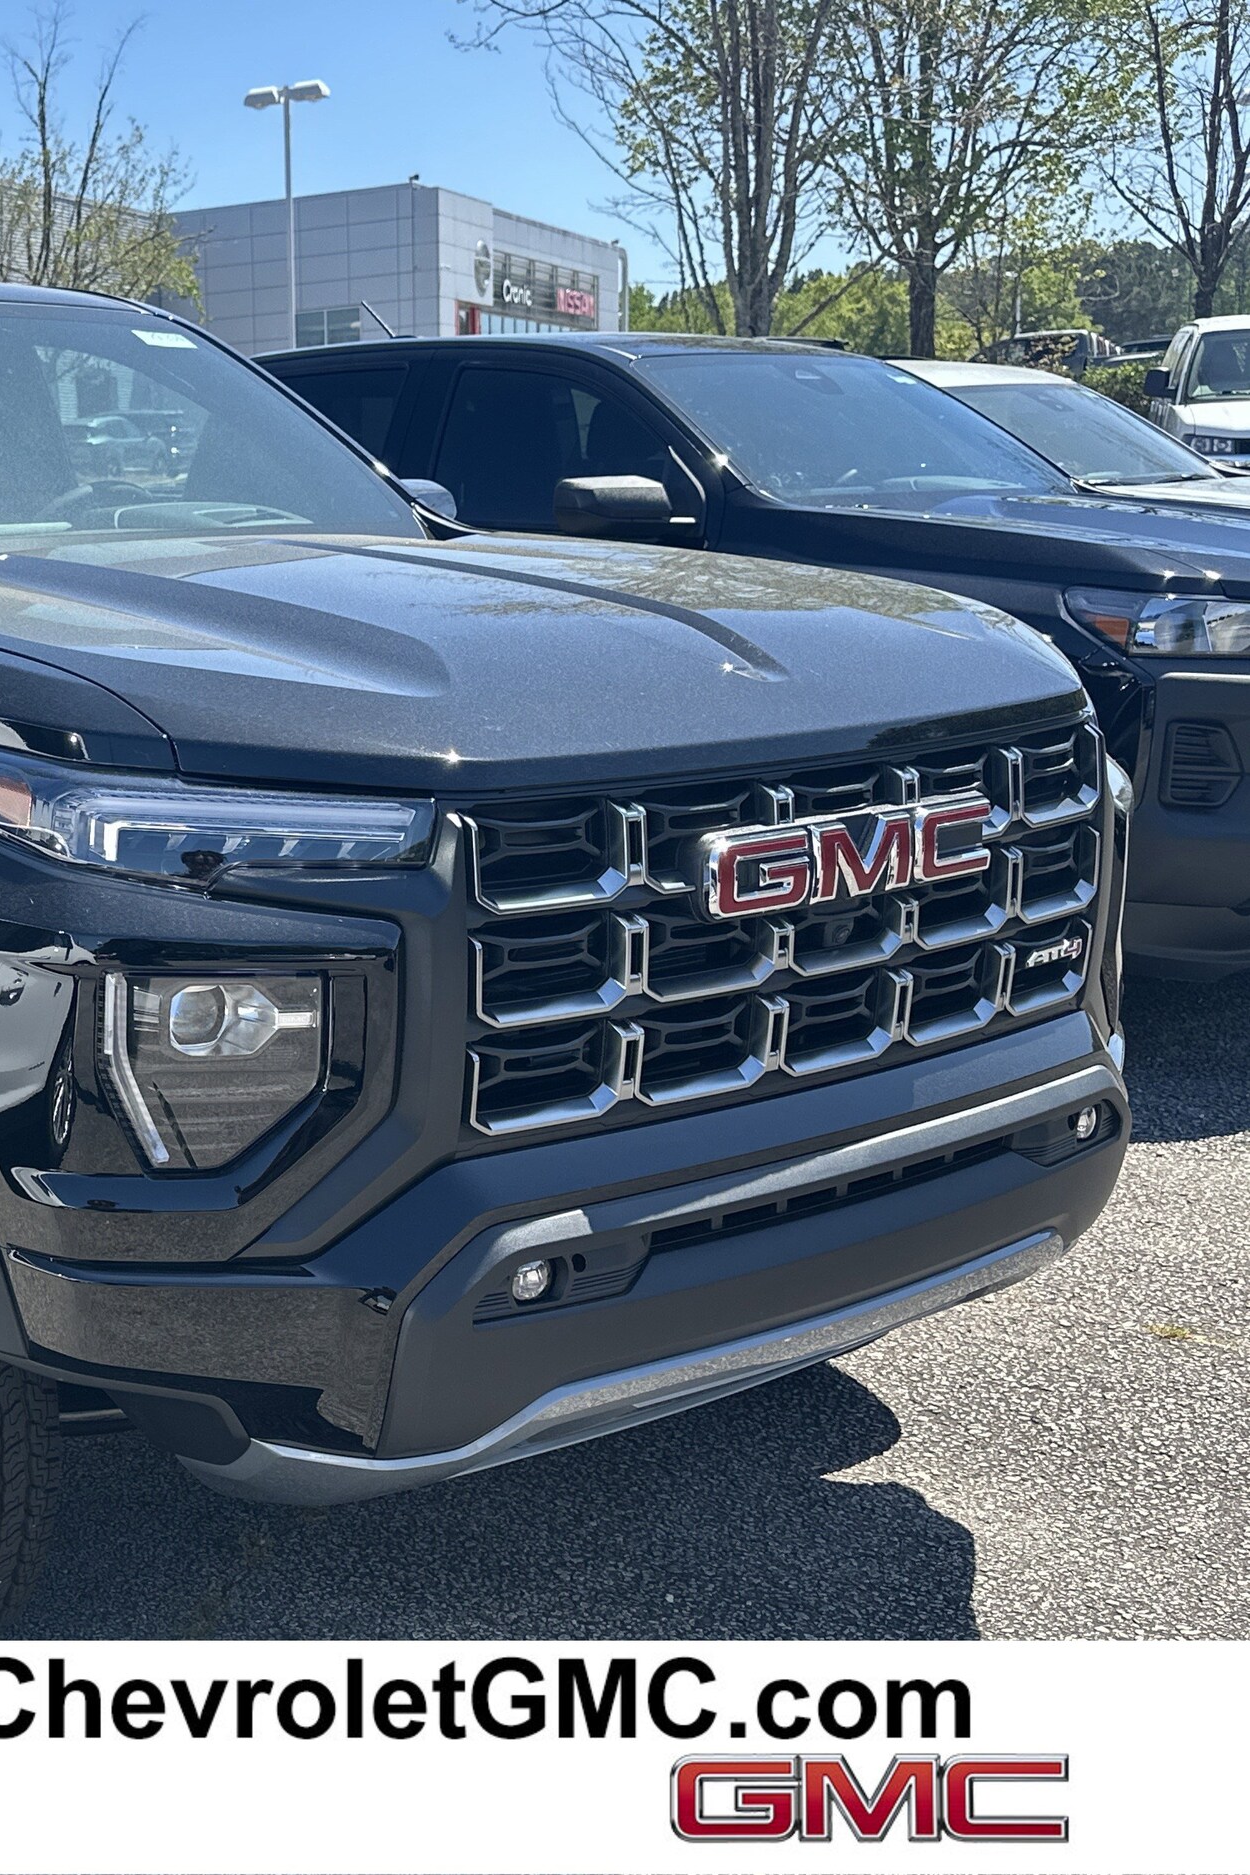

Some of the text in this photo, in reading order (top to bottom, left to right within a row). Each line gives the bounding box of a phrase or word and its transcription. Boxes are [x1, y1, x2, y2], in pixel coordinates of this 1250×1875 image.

[503, 279, 595, 319] Cronic NISSAN
[709, 796, 991, 920] GMC
[1026, 938, 1082, 968] AT4
